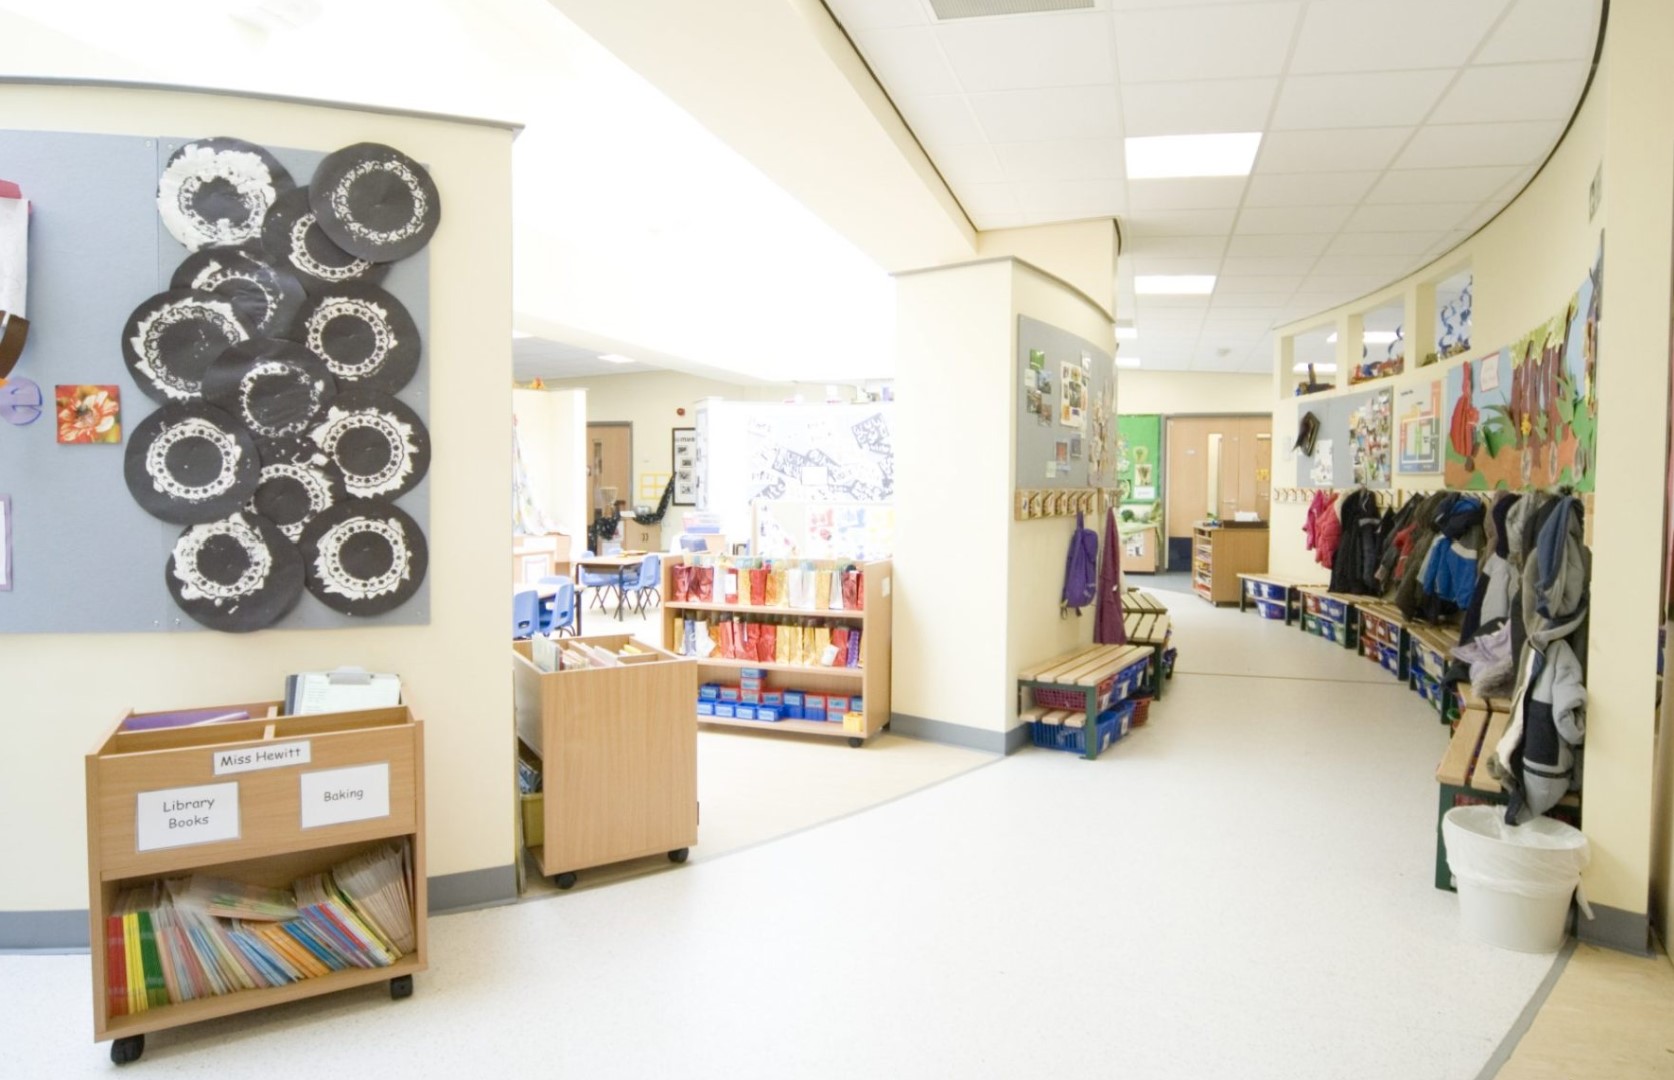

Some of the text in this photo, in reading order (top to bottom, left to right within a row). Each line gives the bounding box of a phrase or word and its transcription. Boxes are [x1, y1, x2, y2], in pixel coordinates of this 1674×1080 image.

[220, 748, 301, 767] Miss Hewitt
[323, 787, 364, 802] Baking
[163, 796, 216, 814] Library
[168, 814, 209, 829] Books
